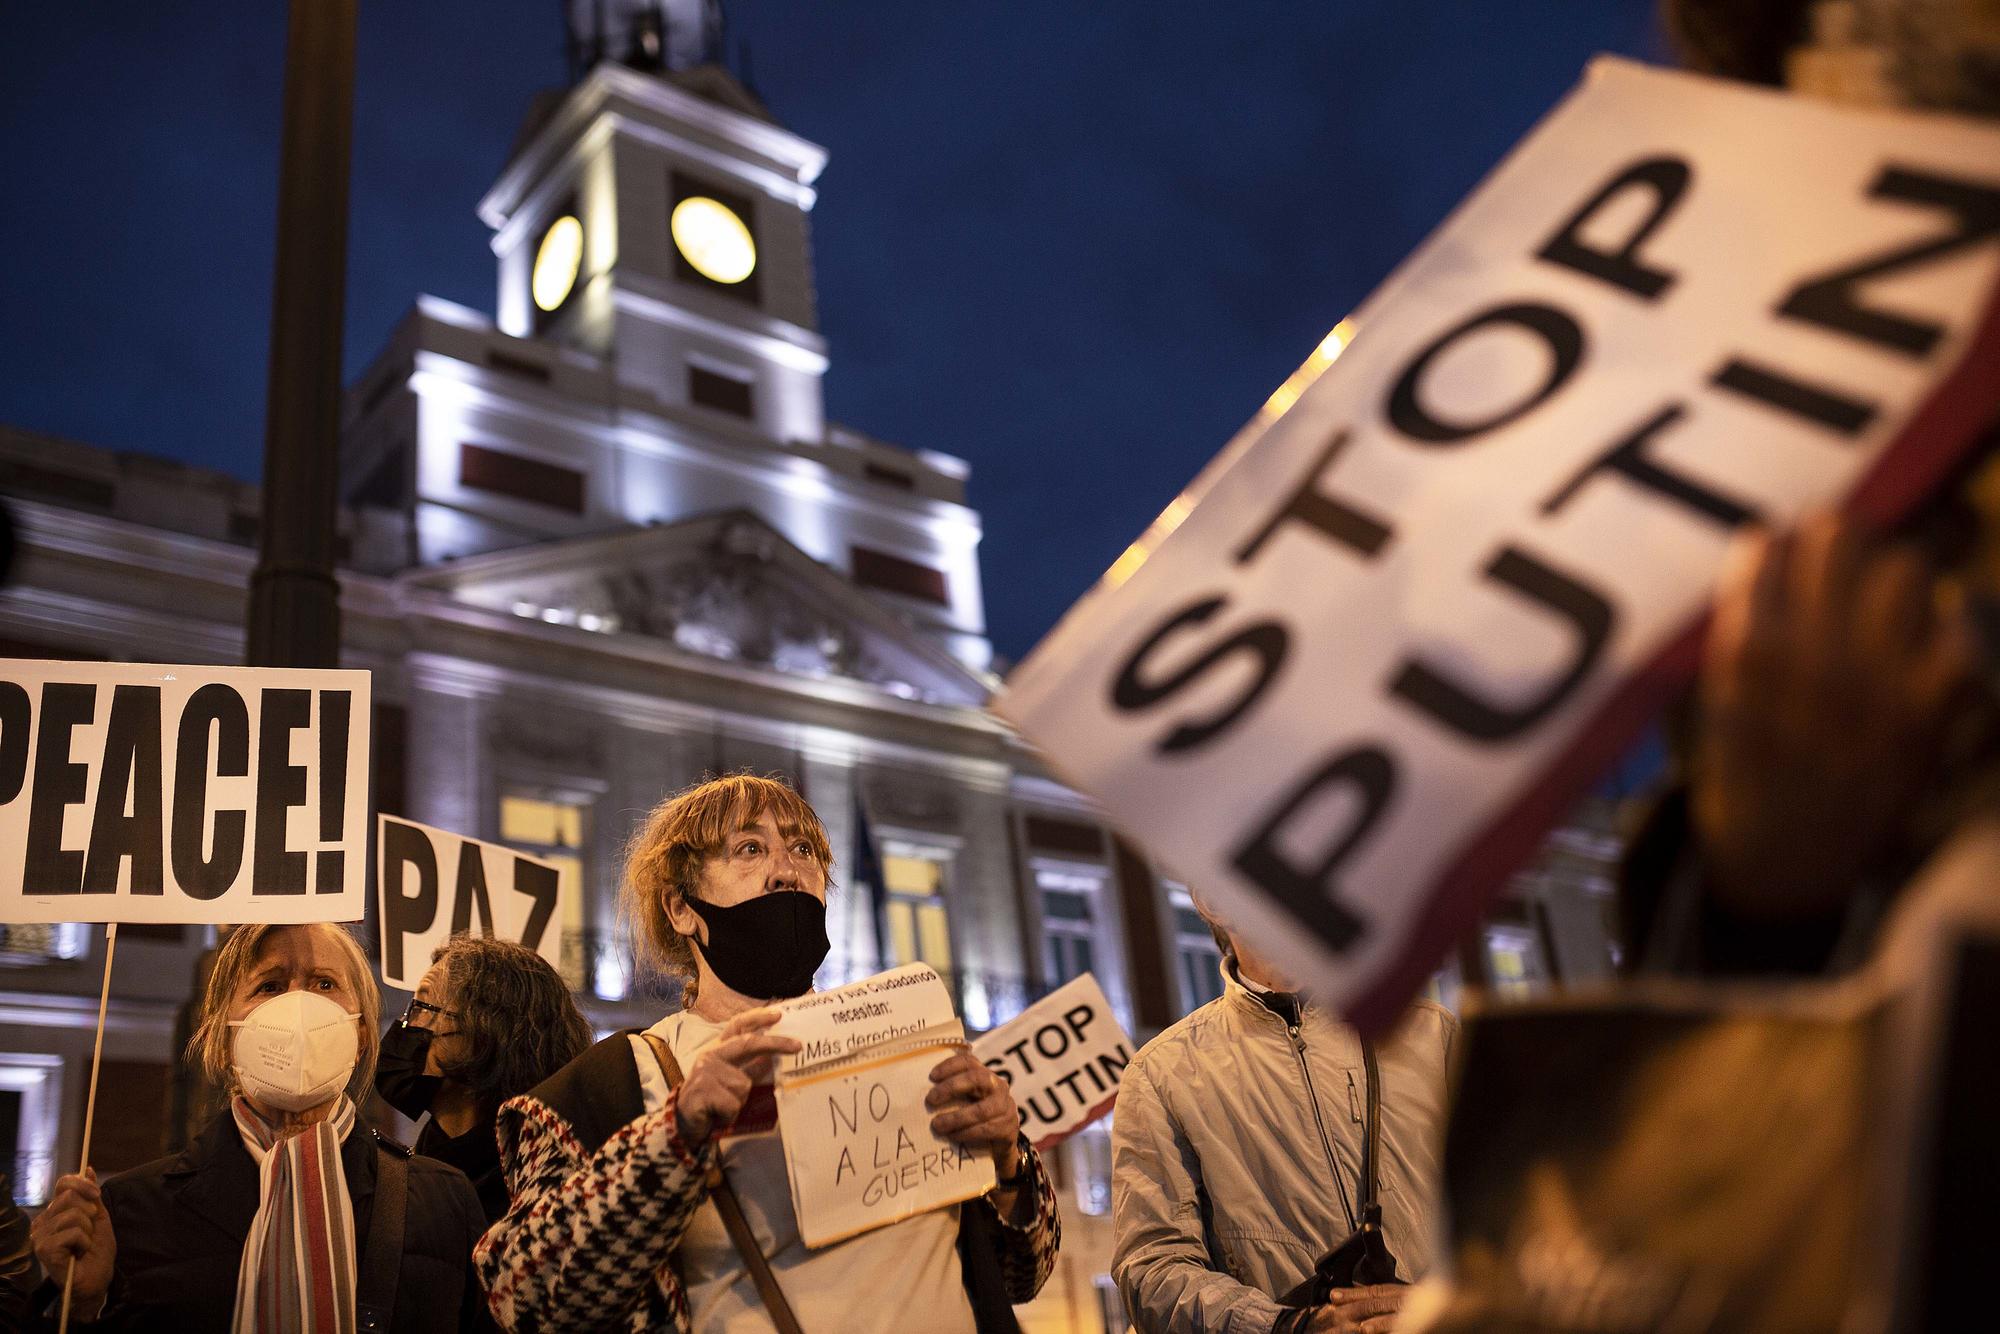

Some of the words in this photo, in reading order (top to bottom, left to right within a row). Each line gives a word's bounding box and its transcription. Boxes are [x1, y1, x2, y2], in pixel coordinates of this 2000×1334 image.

[1107, 153, 1694, 760] STOP
[1223, 162, 2000, 959] PUTIN
[831, 1000, 893, 1025] necesitan:
[836, 1147, 856, 1186] A
[873, 1126, 916, 1169] LA
[862, 1141, 975, 1207] GUERRA
